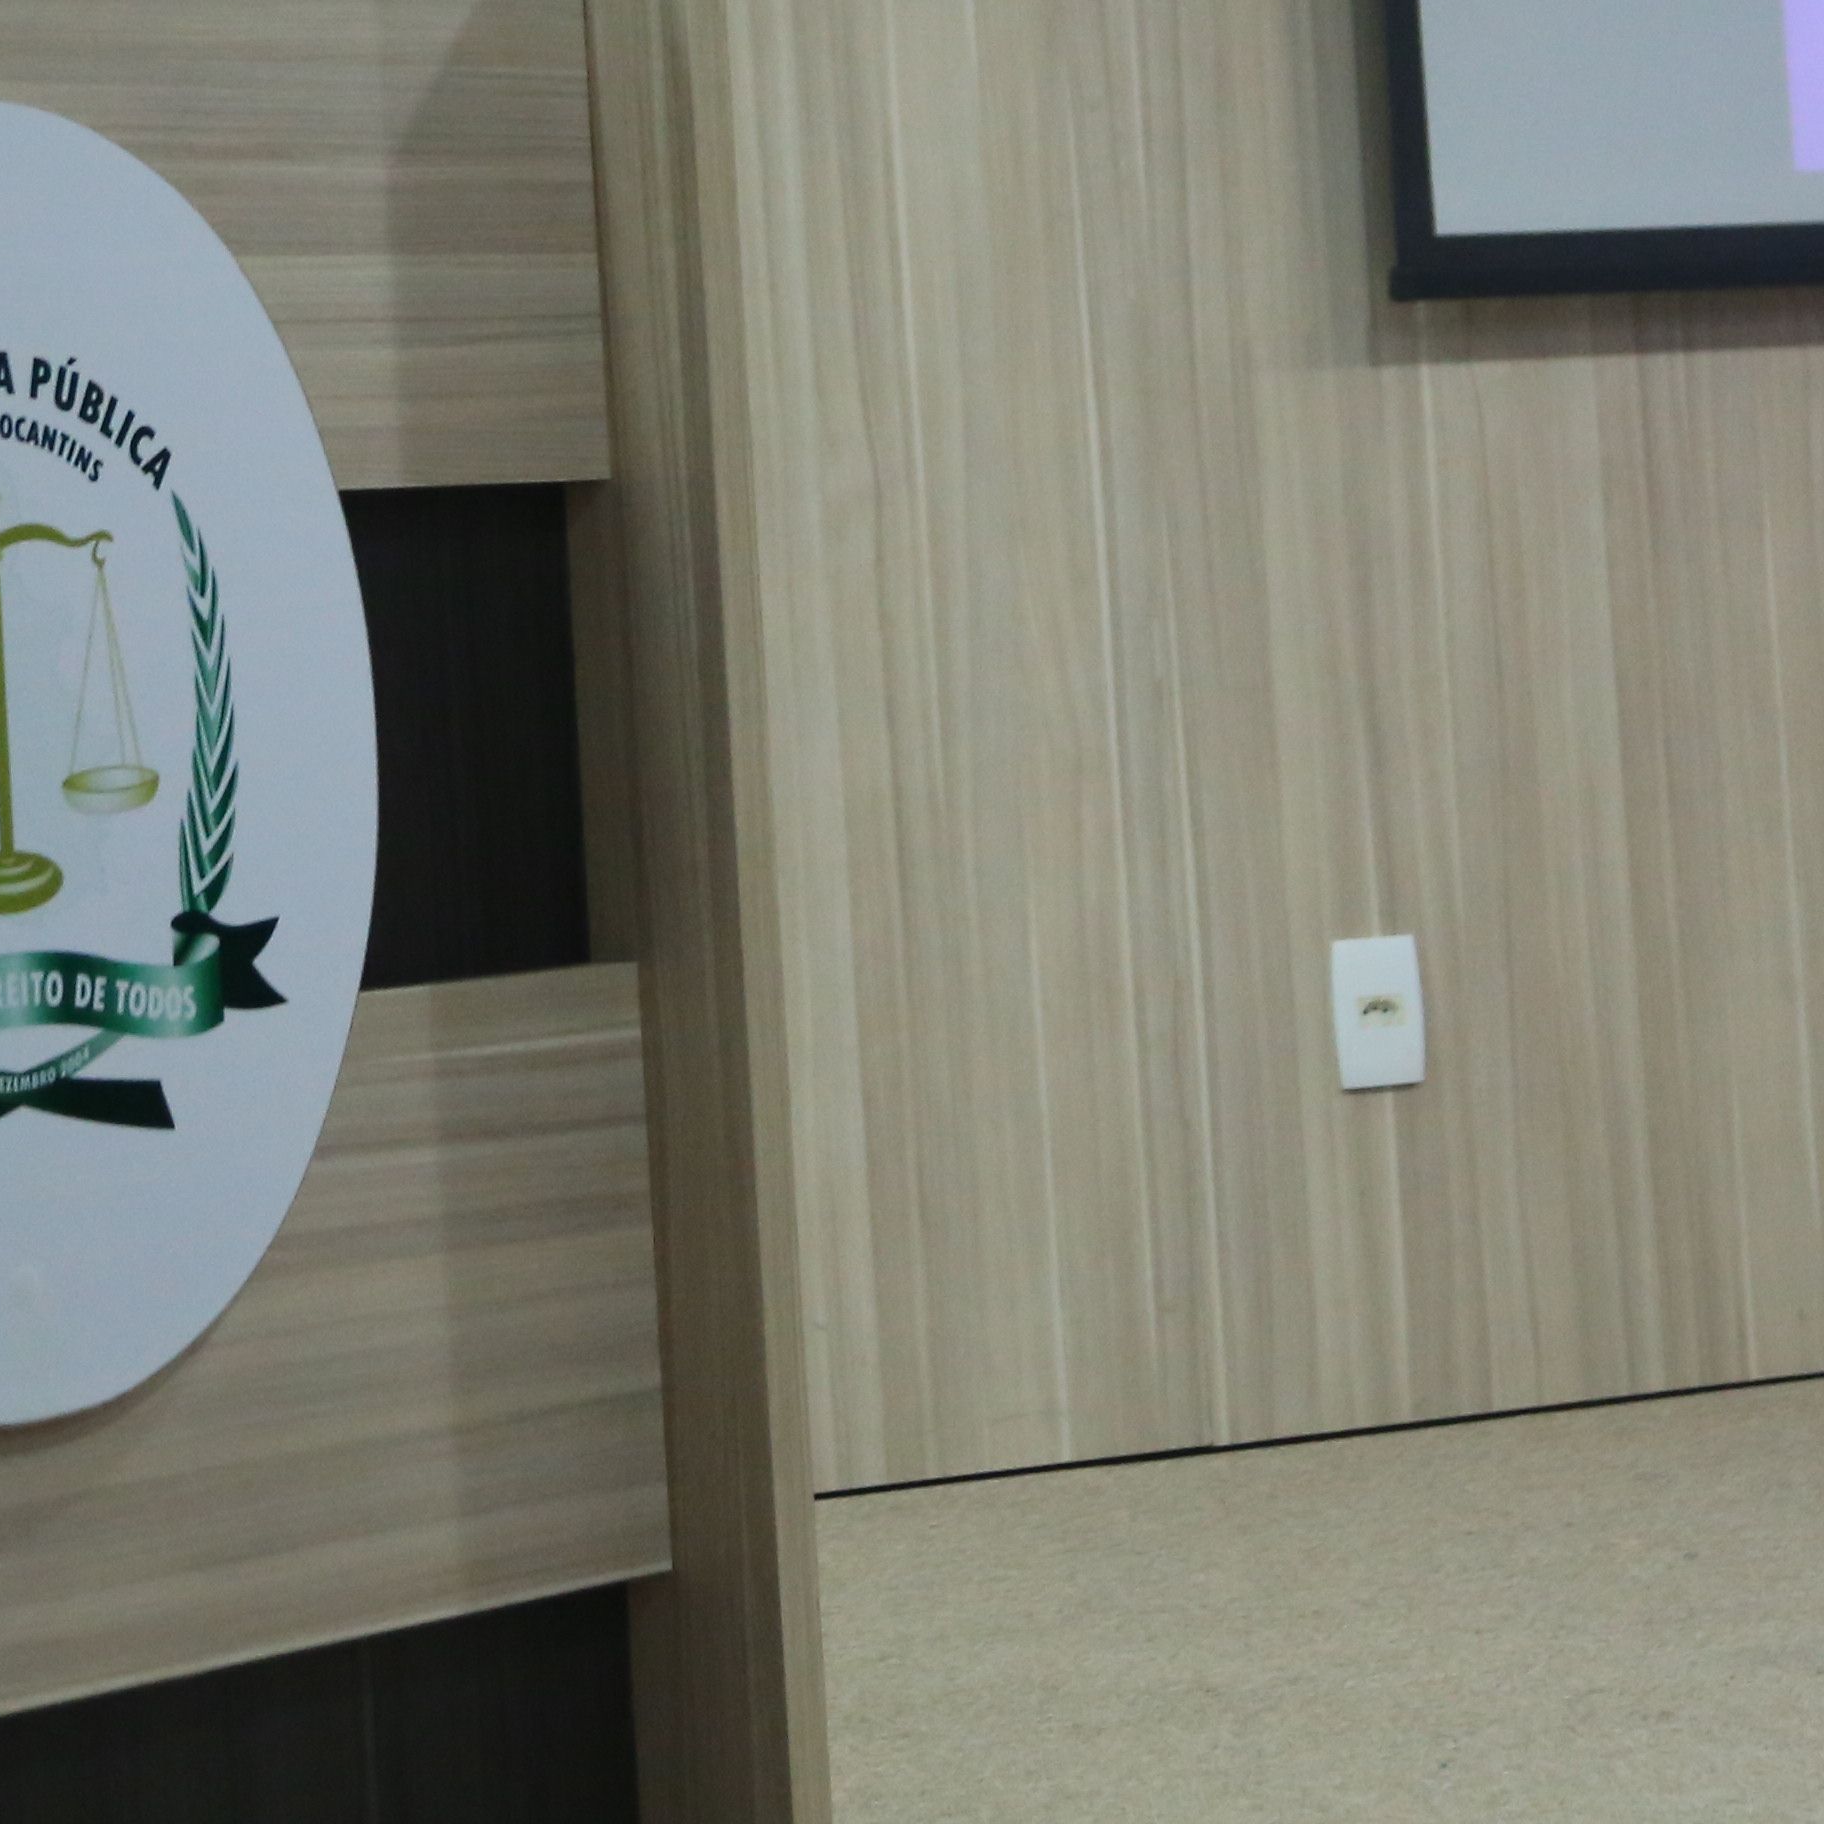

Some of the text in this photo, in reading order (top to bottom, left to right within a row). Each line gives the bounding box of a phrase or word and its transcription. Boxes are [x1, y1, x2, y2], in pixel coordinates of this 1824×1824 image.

[29, 357, 172, 491] PÚBLICA
[74, 973, 106, 1011] DE
[114, 979, 199, 1021] TODOS
